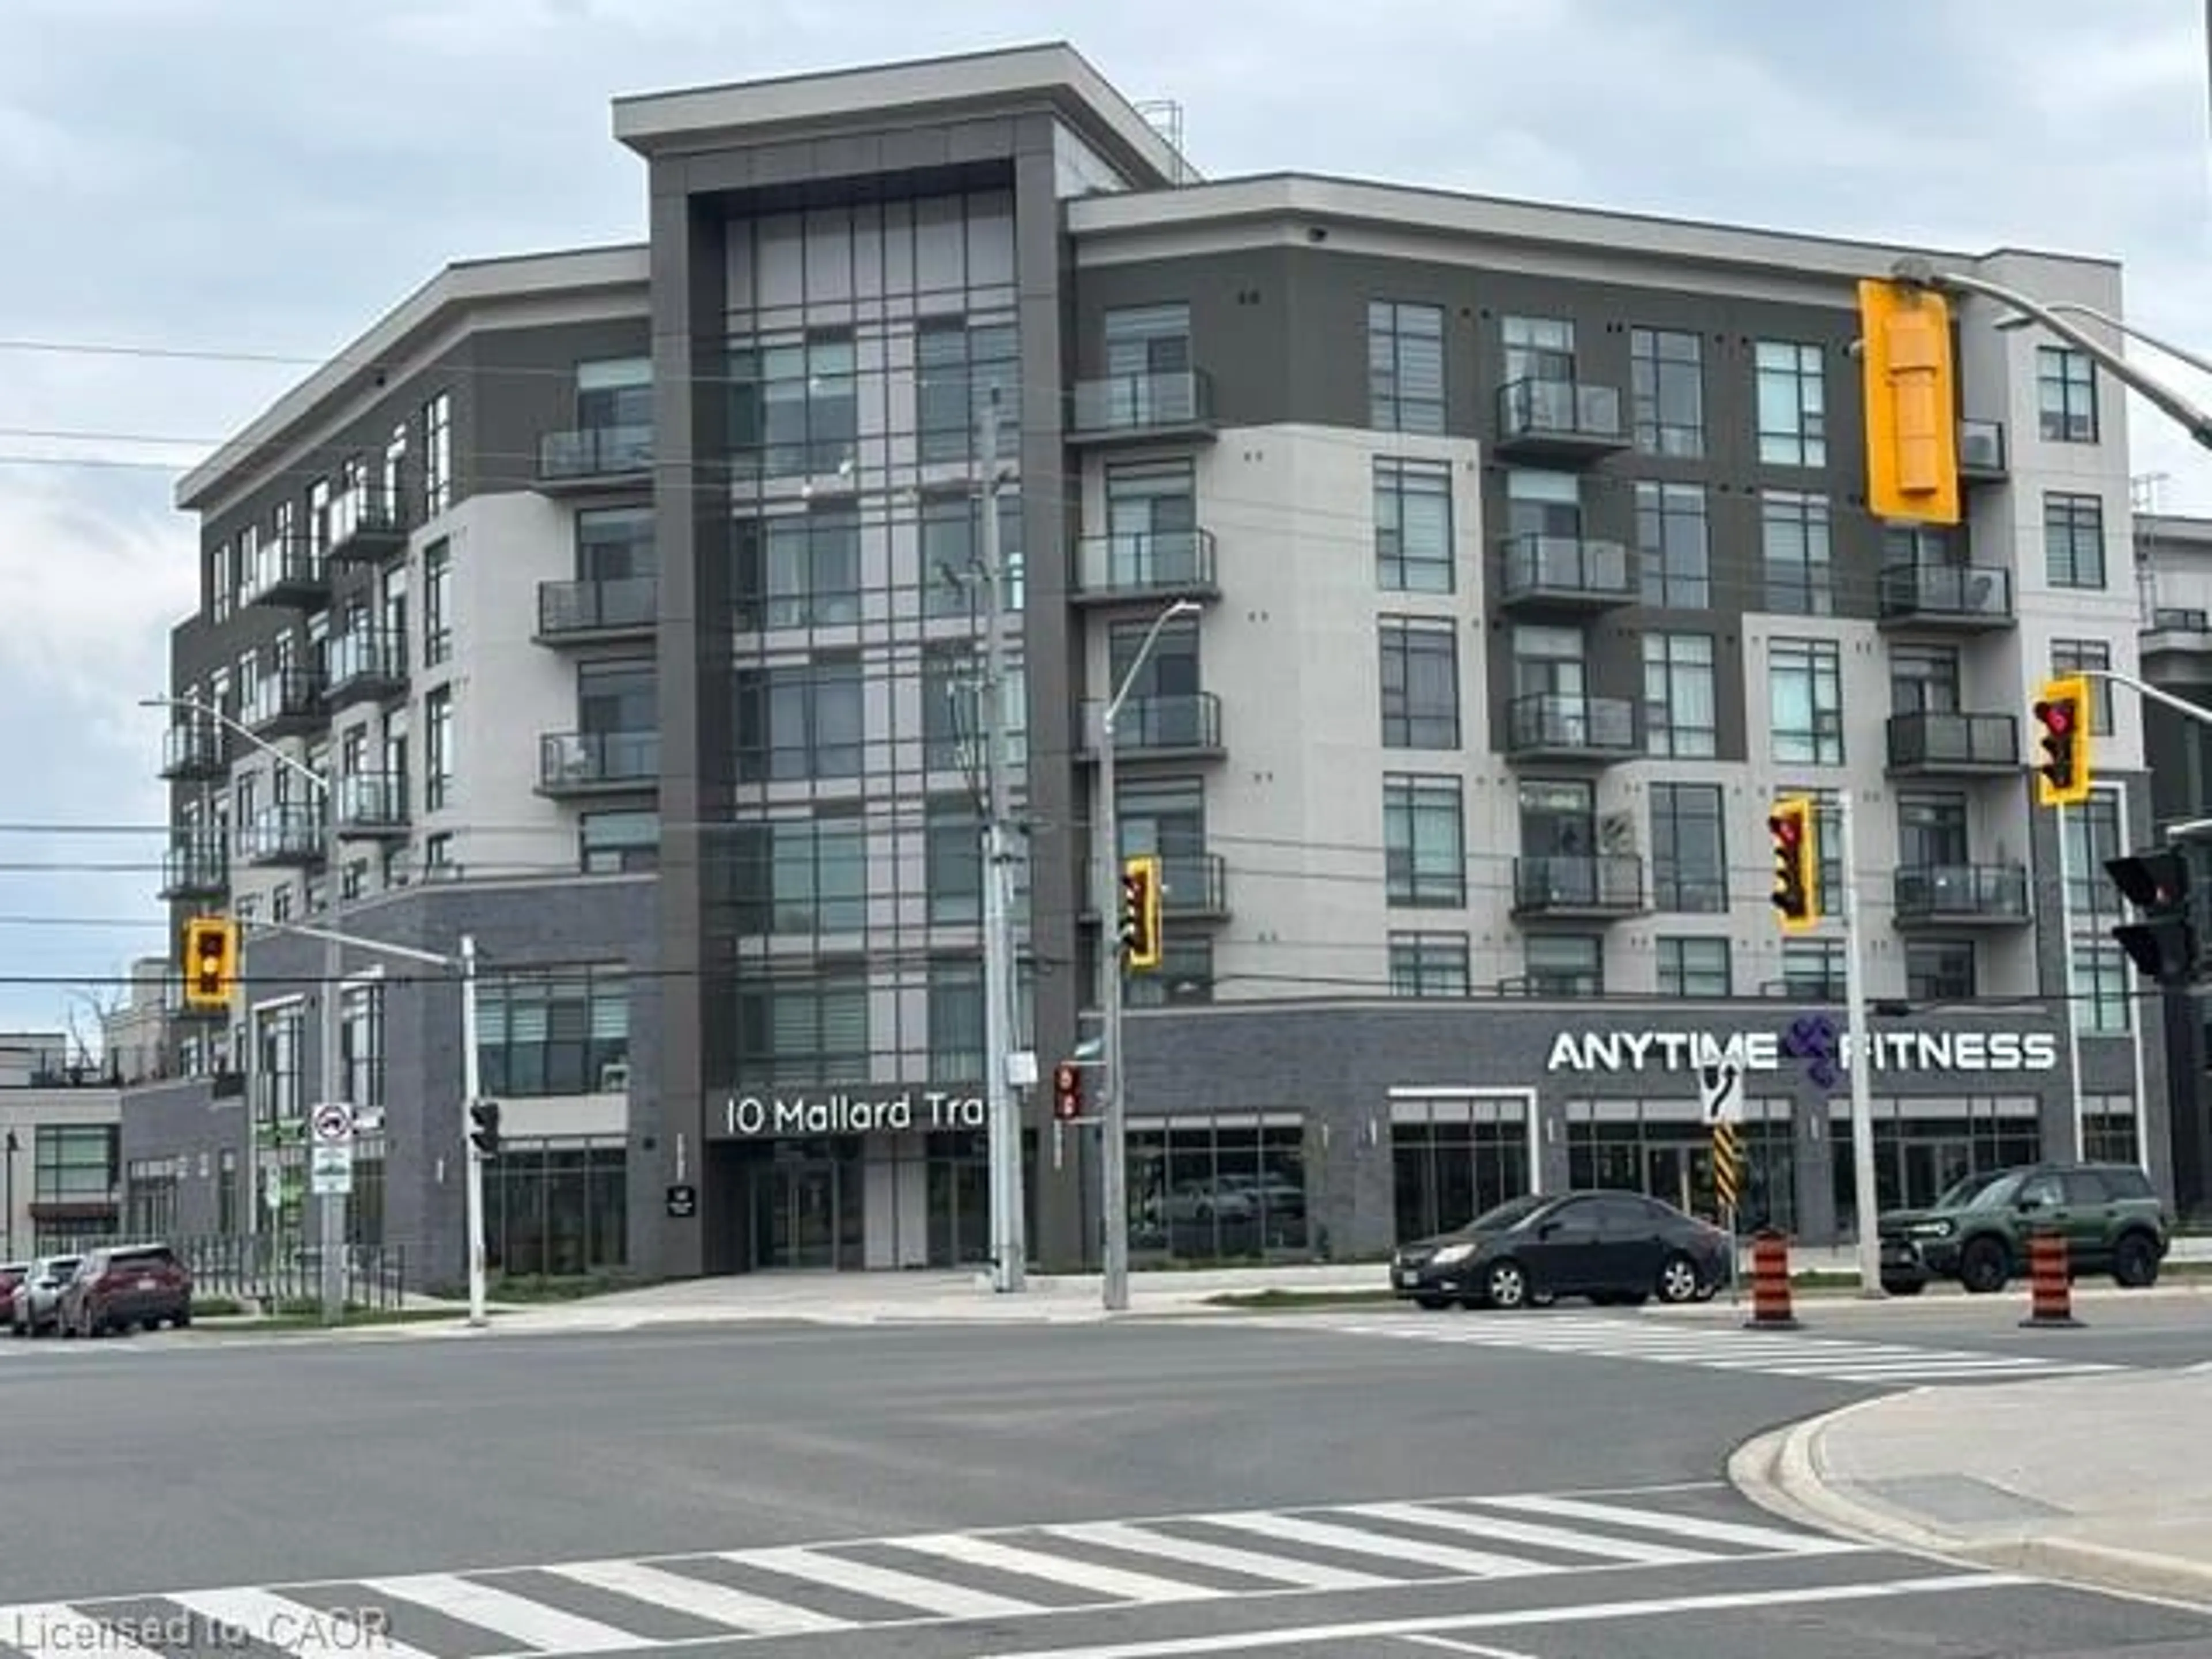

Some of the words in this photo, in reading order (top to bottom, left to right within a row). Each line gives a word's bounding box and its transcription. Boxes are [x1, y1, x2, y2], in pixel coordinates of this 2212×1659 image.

[1547, 1033, 1778, 1071] ANYTIME
[1839, 1033, 2056, 1070] FITNESS
[728, 1097, 765, 1134] 10
[775, 1092, 910, 1132] Mallard
[923, 1092, 983, 1126] Tra
